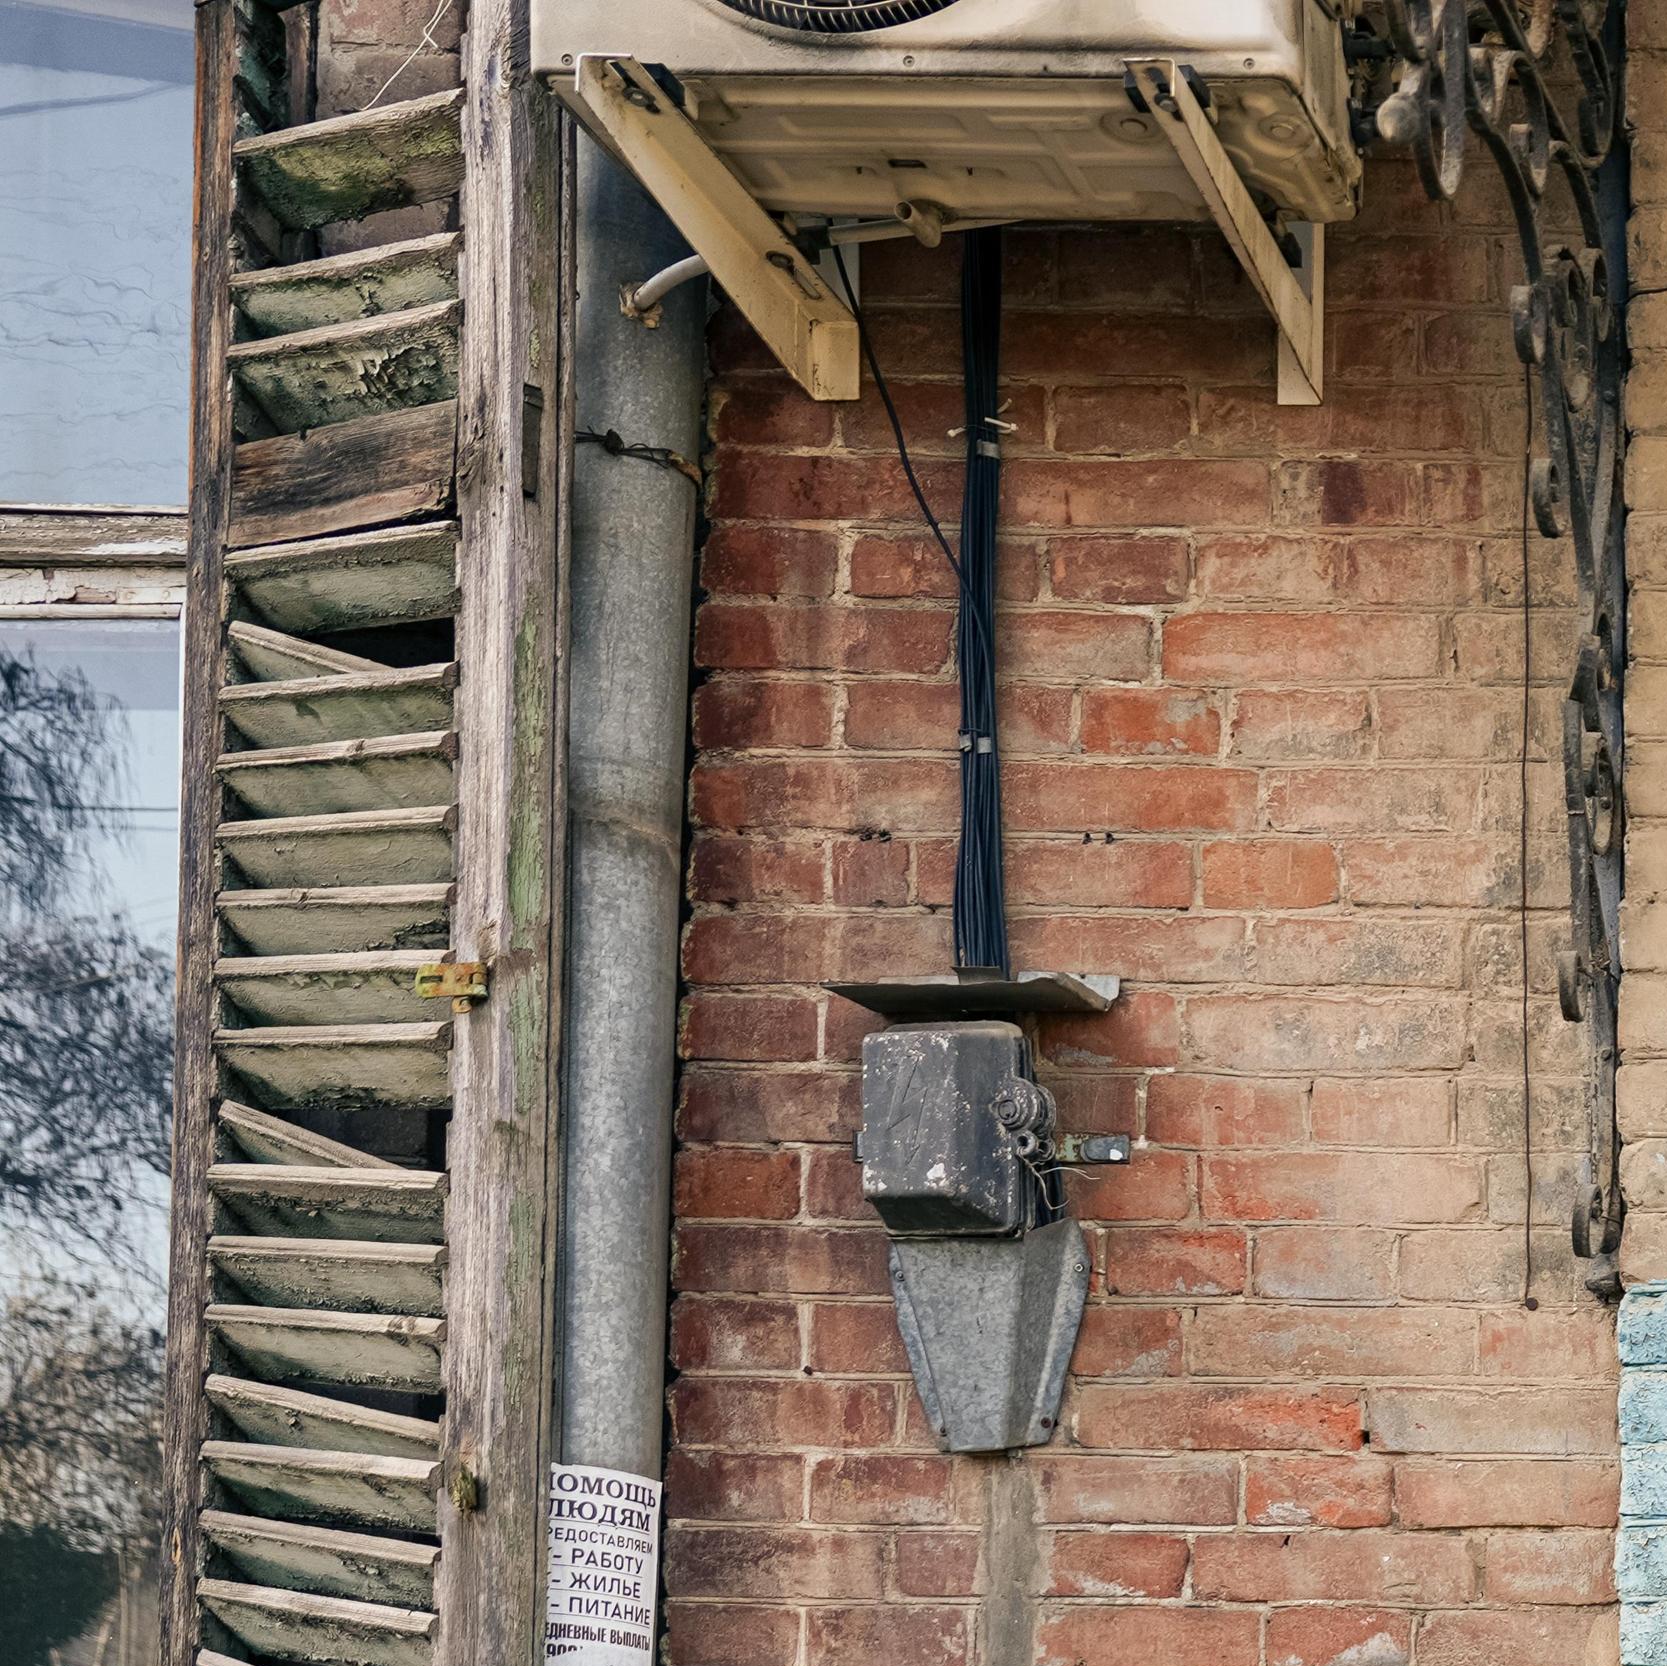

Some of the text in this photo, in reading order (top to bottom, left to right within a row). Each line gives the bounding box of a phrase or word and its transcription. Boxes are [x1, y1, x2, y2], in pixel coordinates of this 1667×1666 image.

[549, 1498, 651, 1532] ЛЮДЯМ
[571, 1548, 643, 1574] РАБОТУ
[569, 1572, 641, 1598] ЖИЛЬЕ
[568, 1596, 651, 1625] ПИТАНИЕ
